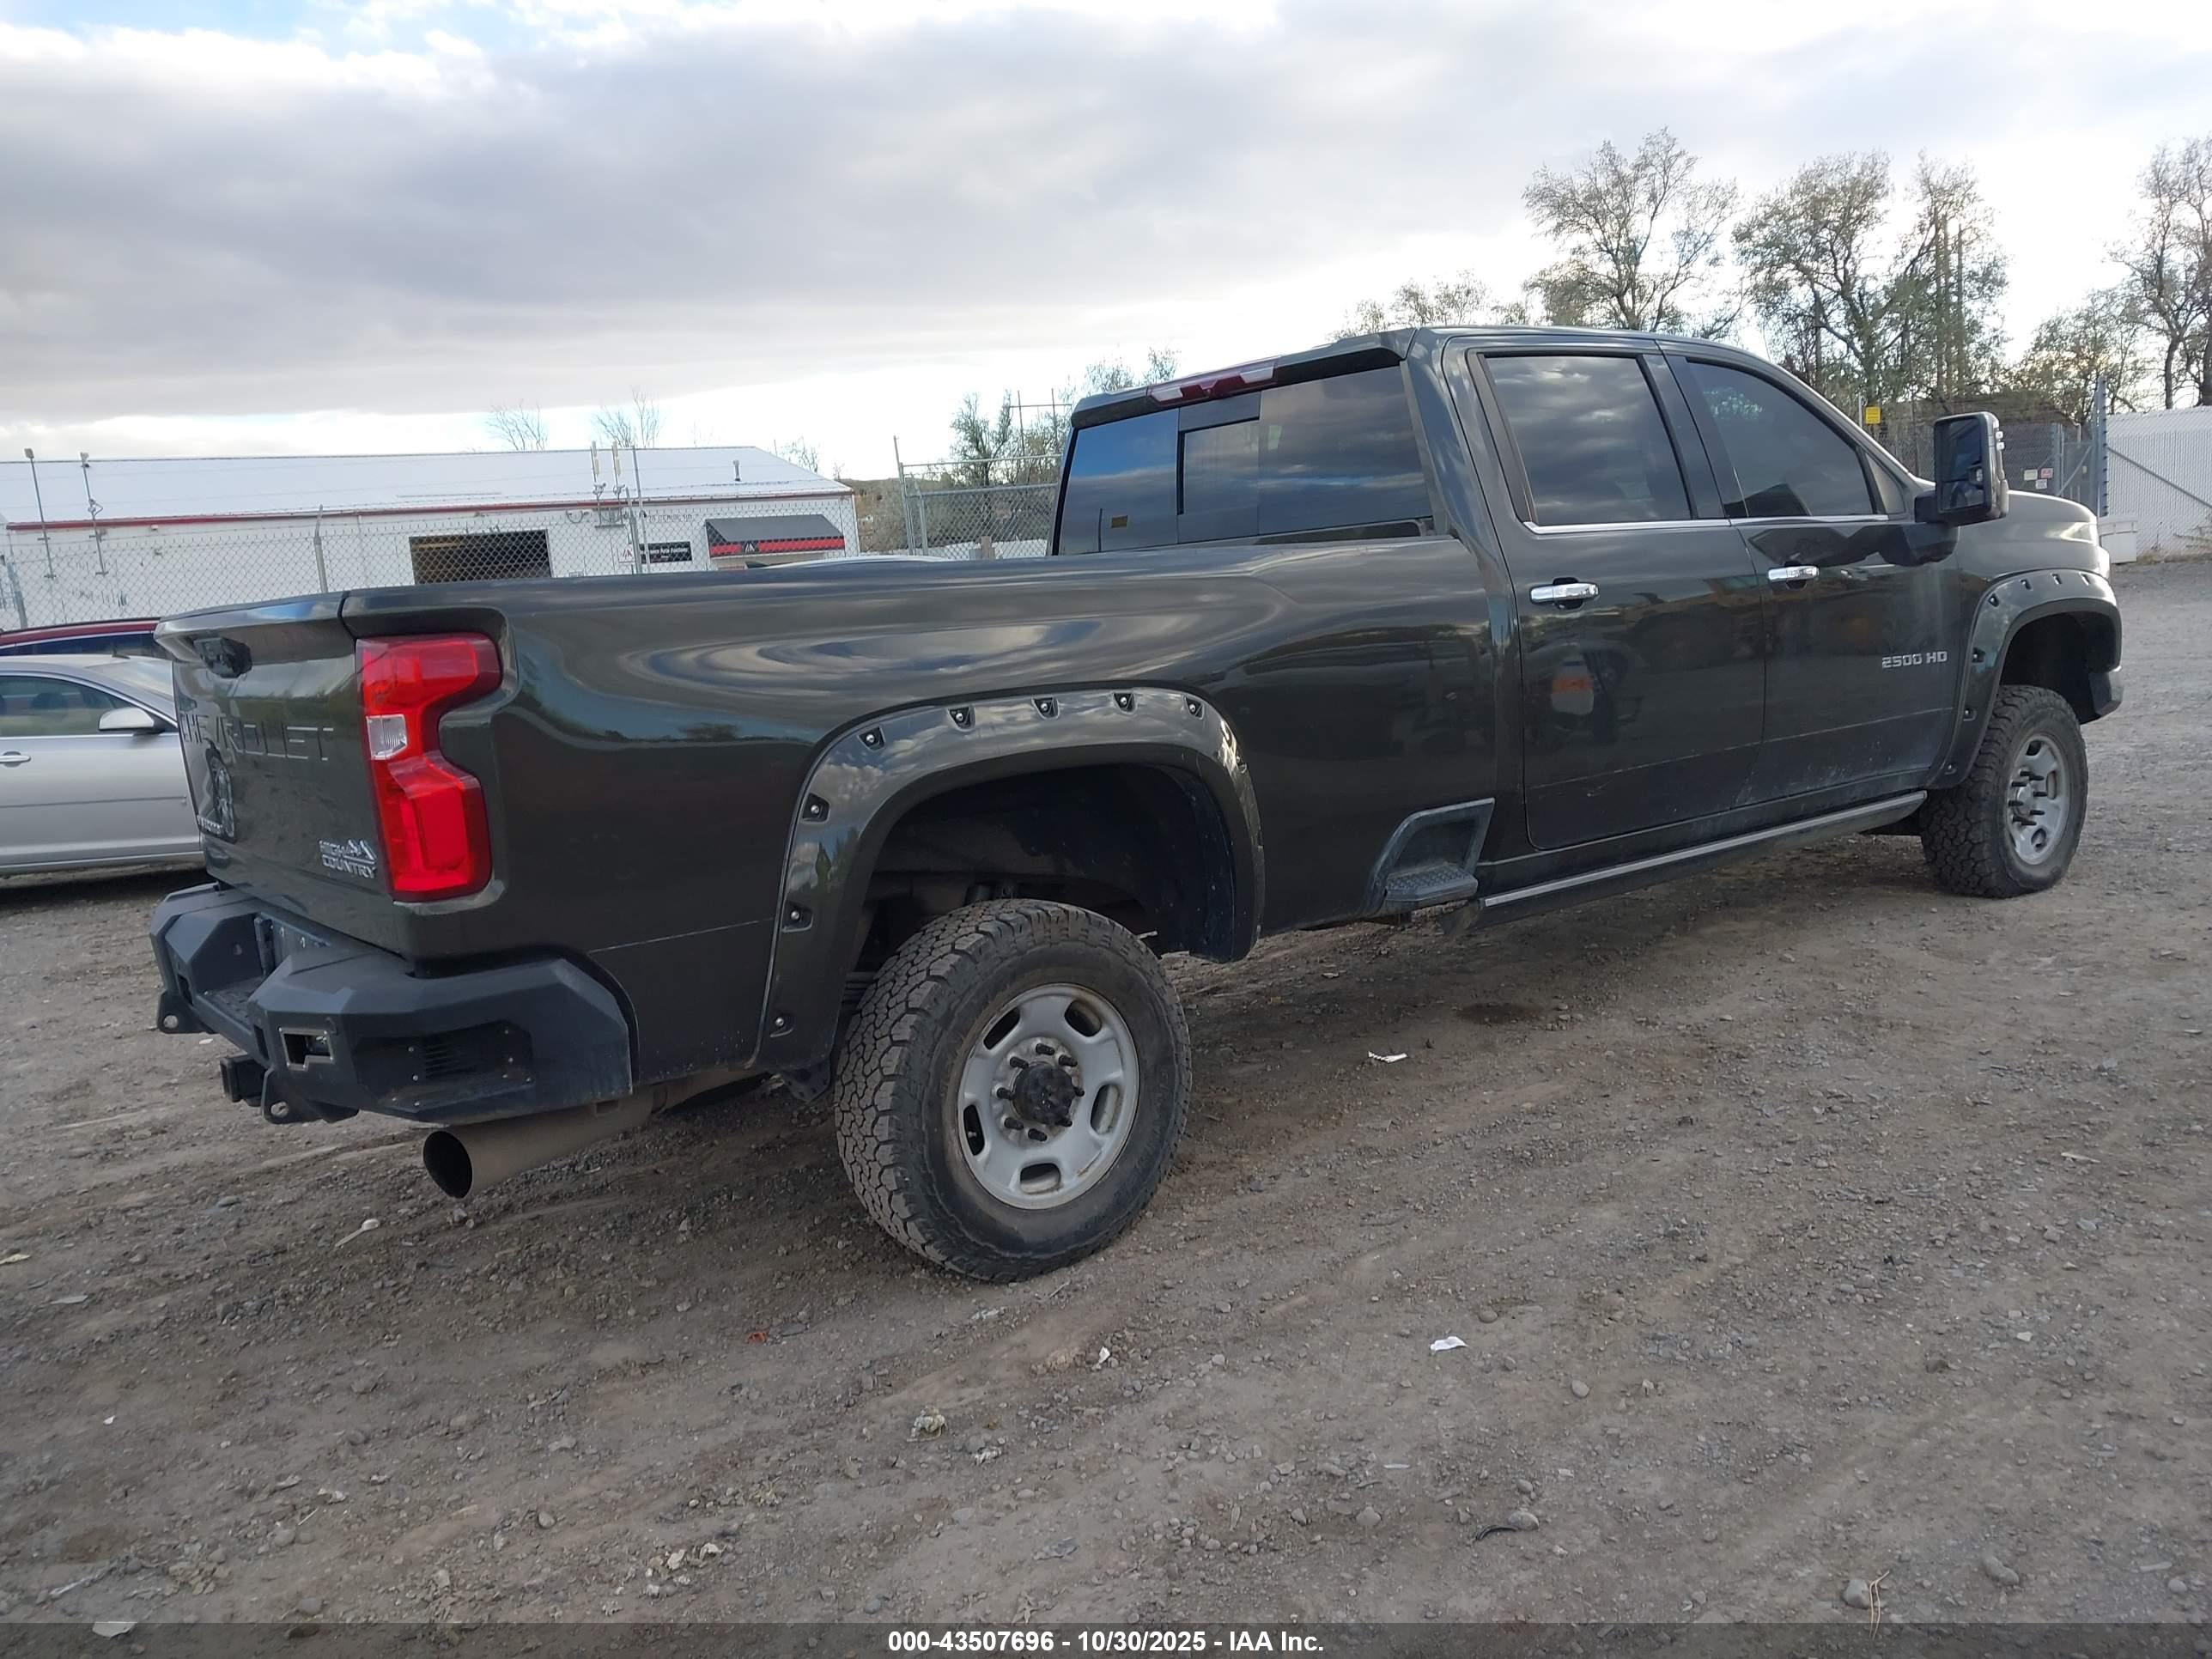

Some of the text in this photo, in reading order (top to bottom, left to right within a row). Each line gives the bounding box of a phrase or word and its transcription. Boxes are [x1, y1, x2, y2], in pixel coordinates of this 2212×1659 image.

[1881, 651, 1948, 668] 2500 HD
[322, 854, 376, 878] COUNTRY
